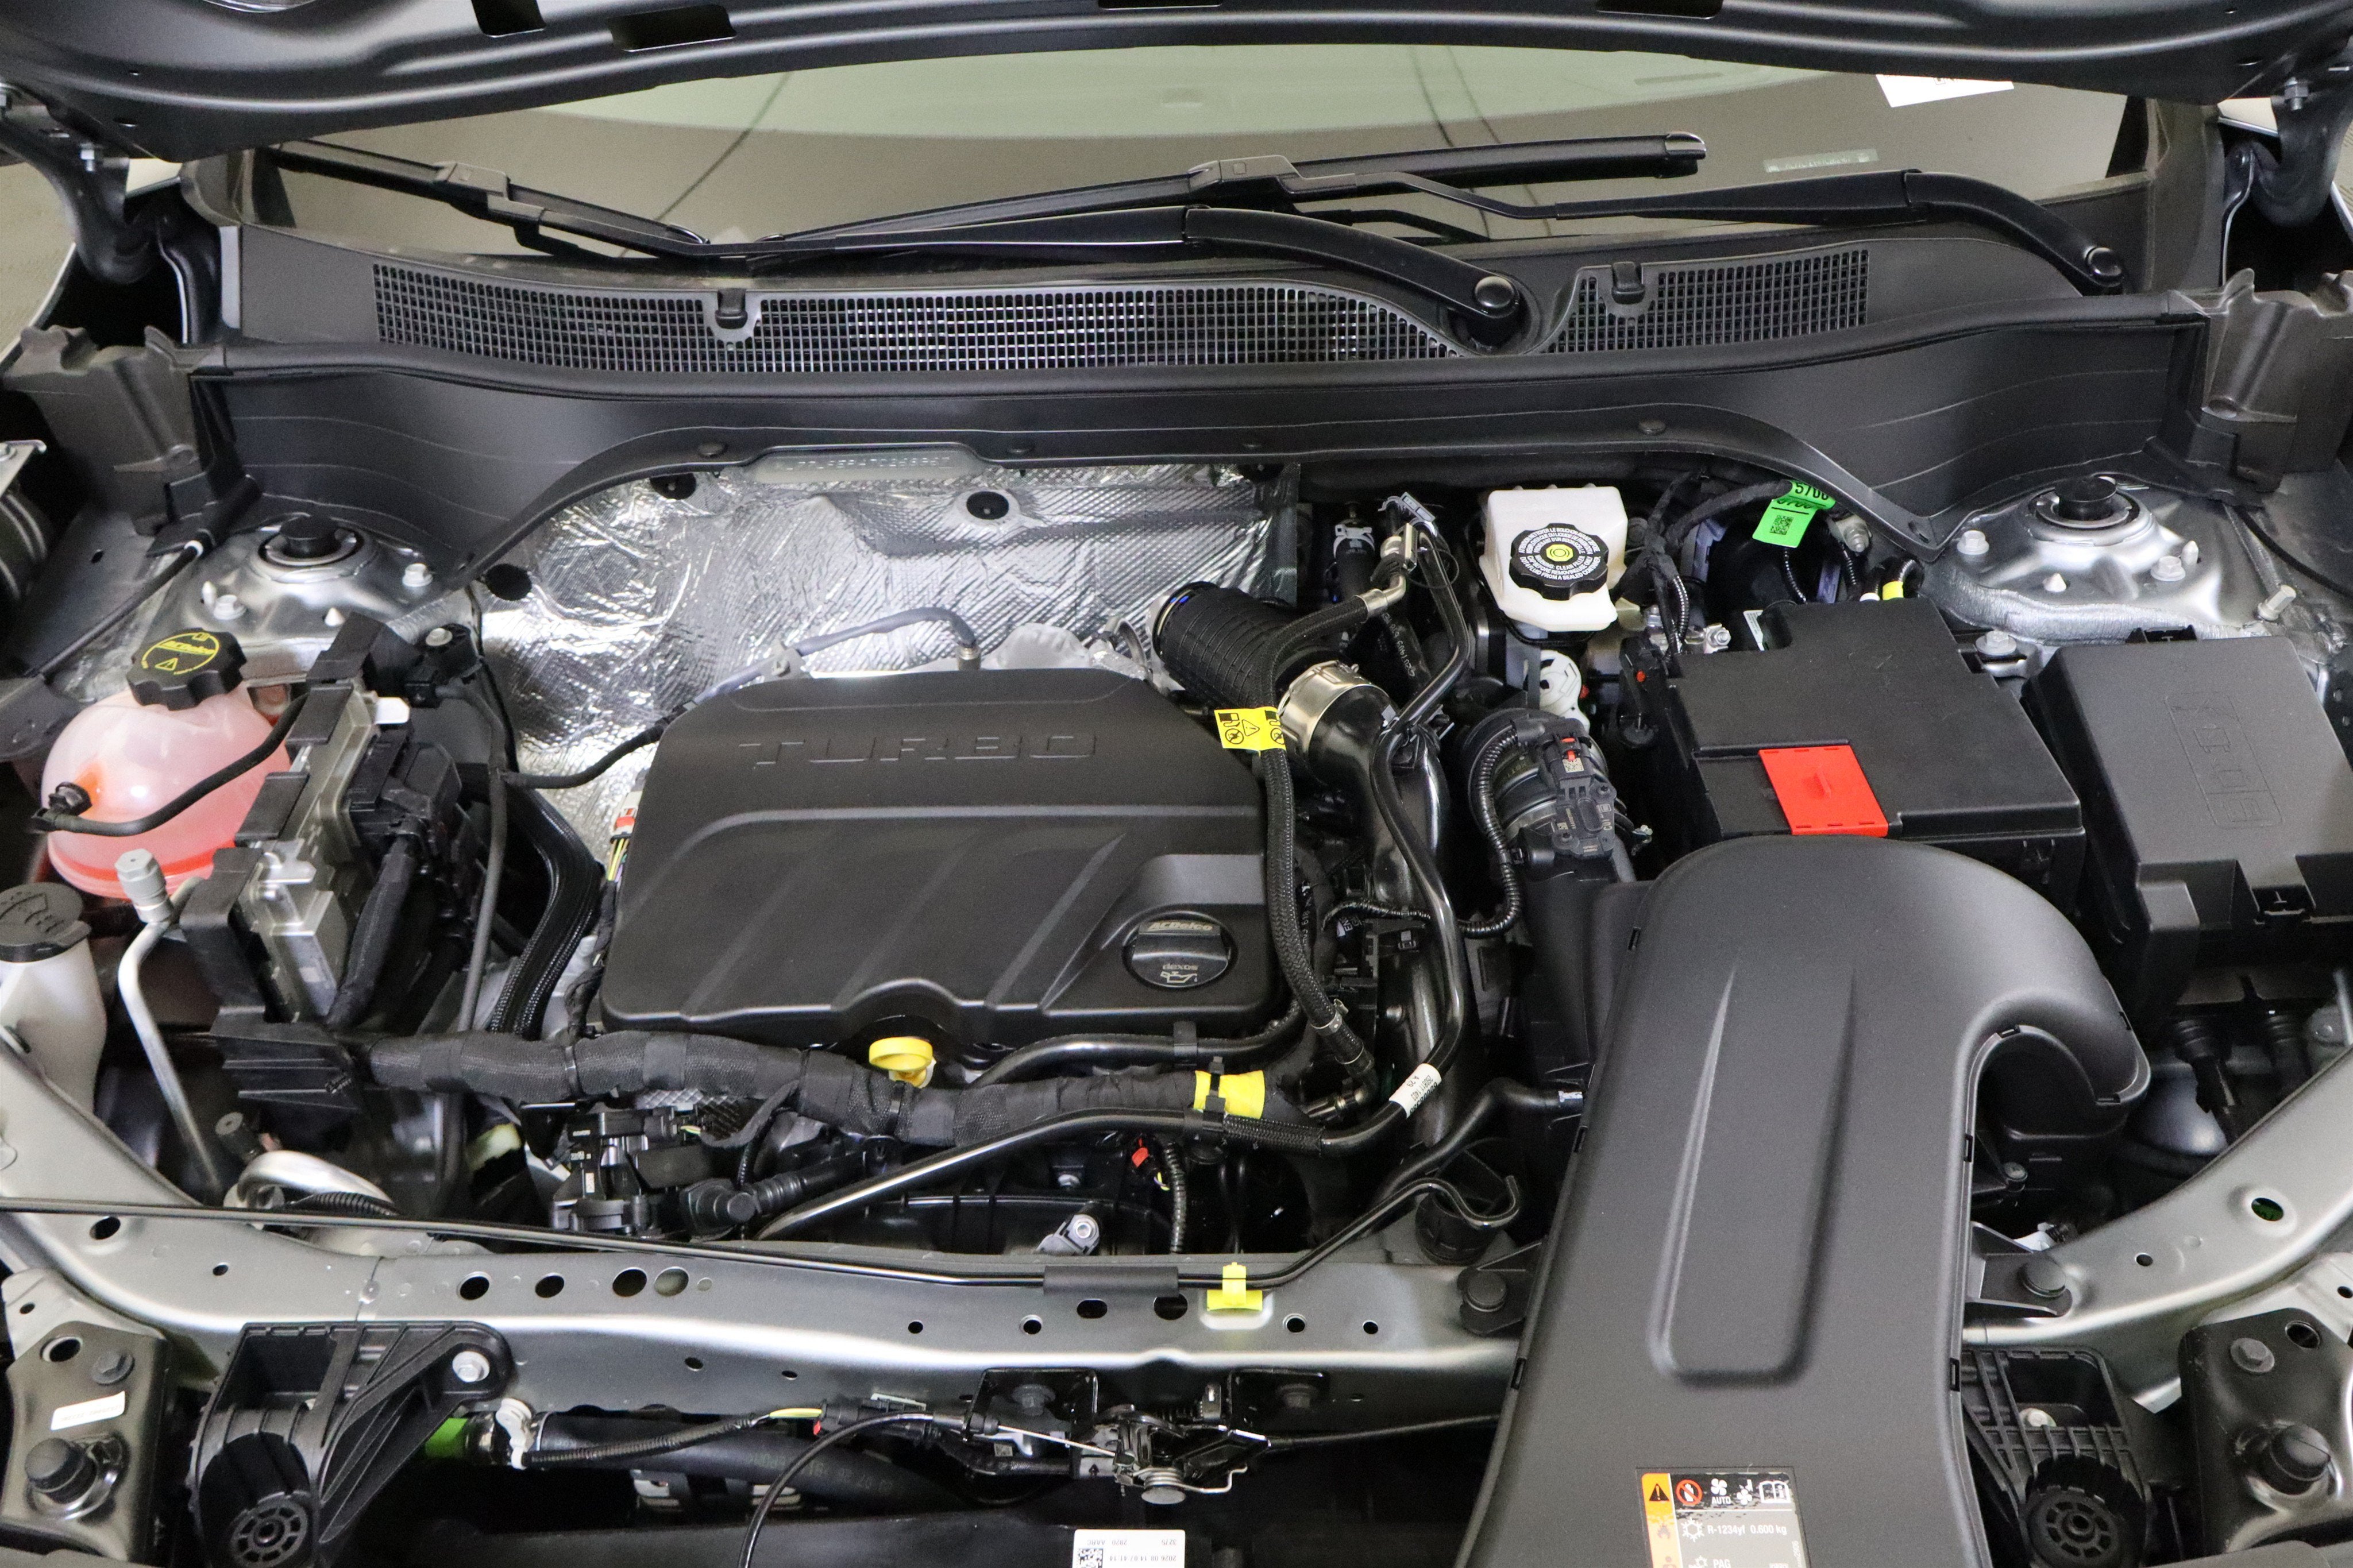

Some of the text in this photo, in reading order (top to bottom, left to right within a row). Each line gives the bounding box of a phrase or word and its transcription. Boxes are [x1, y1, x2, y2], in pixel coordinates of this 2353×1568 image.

[1527, 566, 1542, 575] FLUID
[1541, 572, 1557, 580] FROM
[1562, 572, 1584, 580] SEALED
[738, 734, 1096, 766] TURBO
[1147, 921, 1213, 931] ACDelco
[1712, 1496, 1731, 1505] AUTO
[1707, 1525, 1787, 1537] R-1234yf 0.600 kg
[1713, 1559, 1731, 1568] PAG
